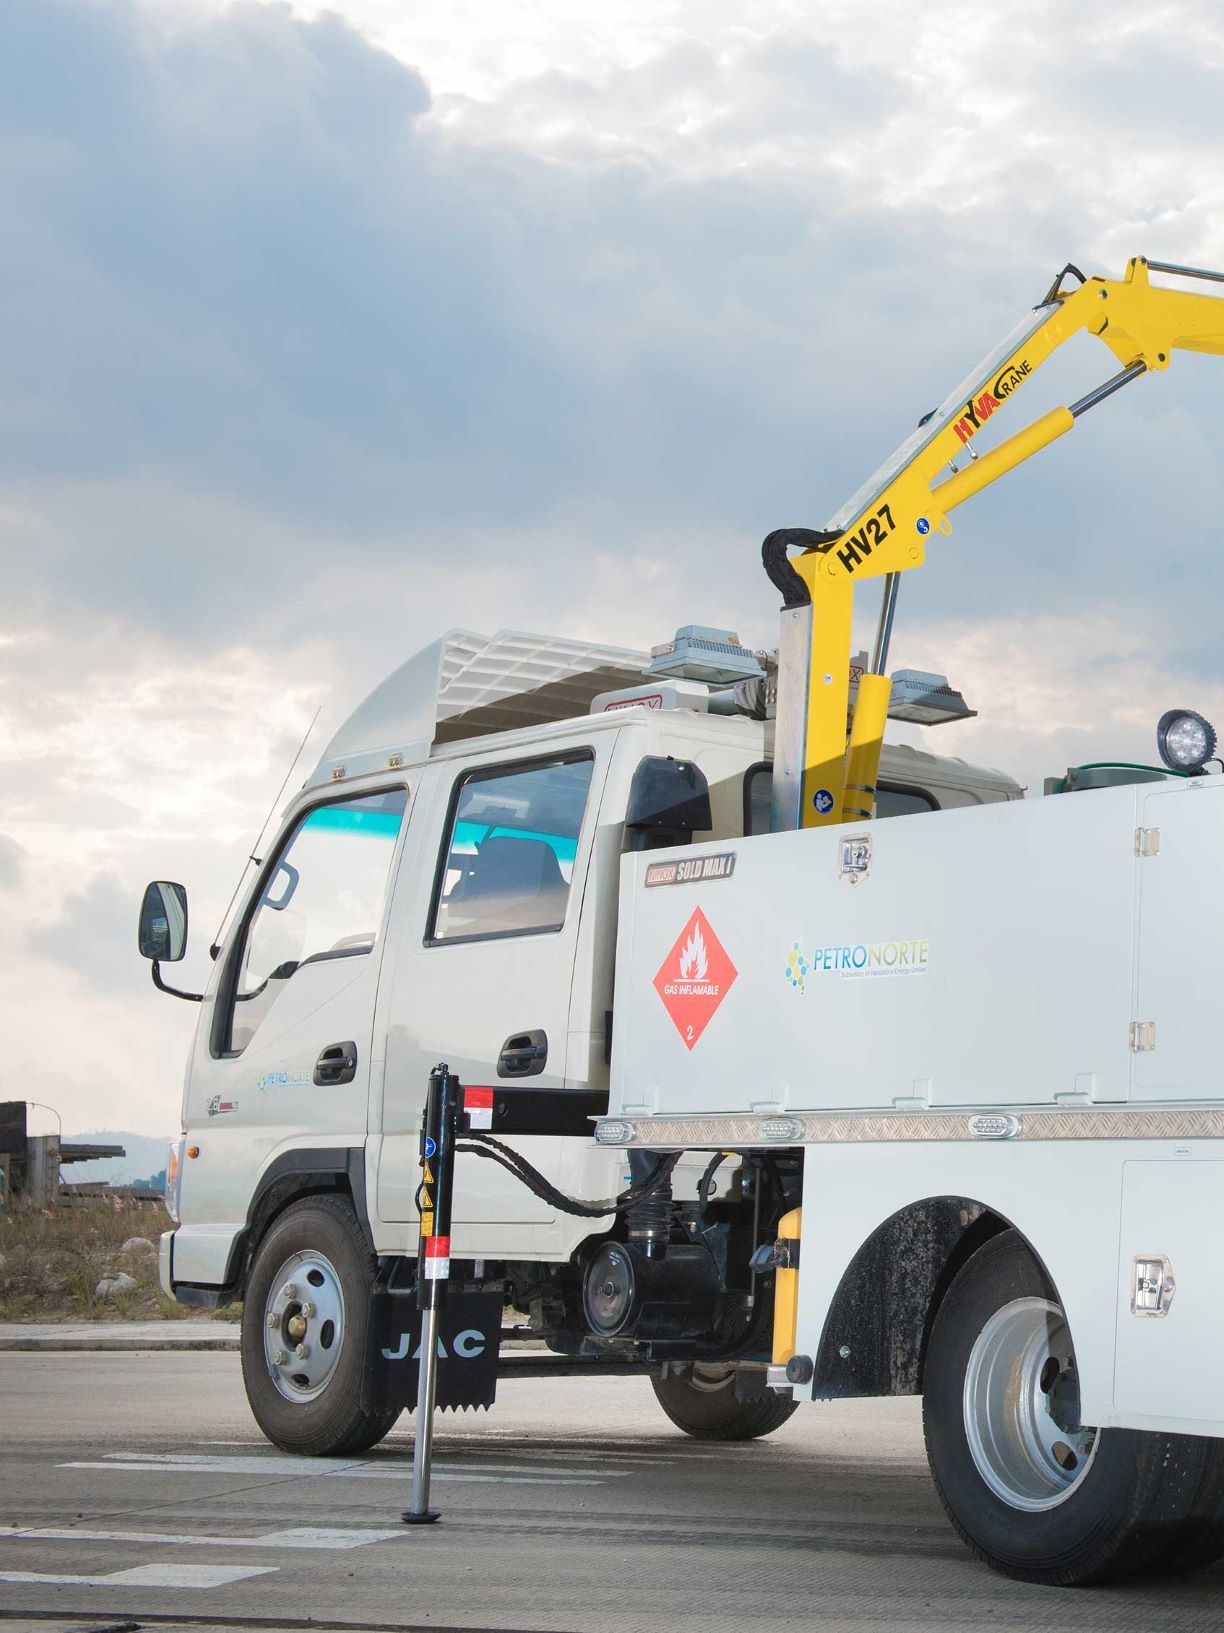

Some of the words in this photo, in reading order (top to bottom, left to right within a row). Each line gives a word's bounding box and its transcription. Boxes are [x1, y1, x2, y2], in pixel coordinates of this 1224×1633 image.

[836, 503, 896, 574] HV27
[677, 860, 703, 881] SOLD
[702, 857, 727, 877] MAX
[813, 940, 928, 970] PETRONORTE
[664, 984, 678, 995] GAS
[678, 984, 719, 995] INFLAMABLE
[686, 1024, 694, 1041] 2
